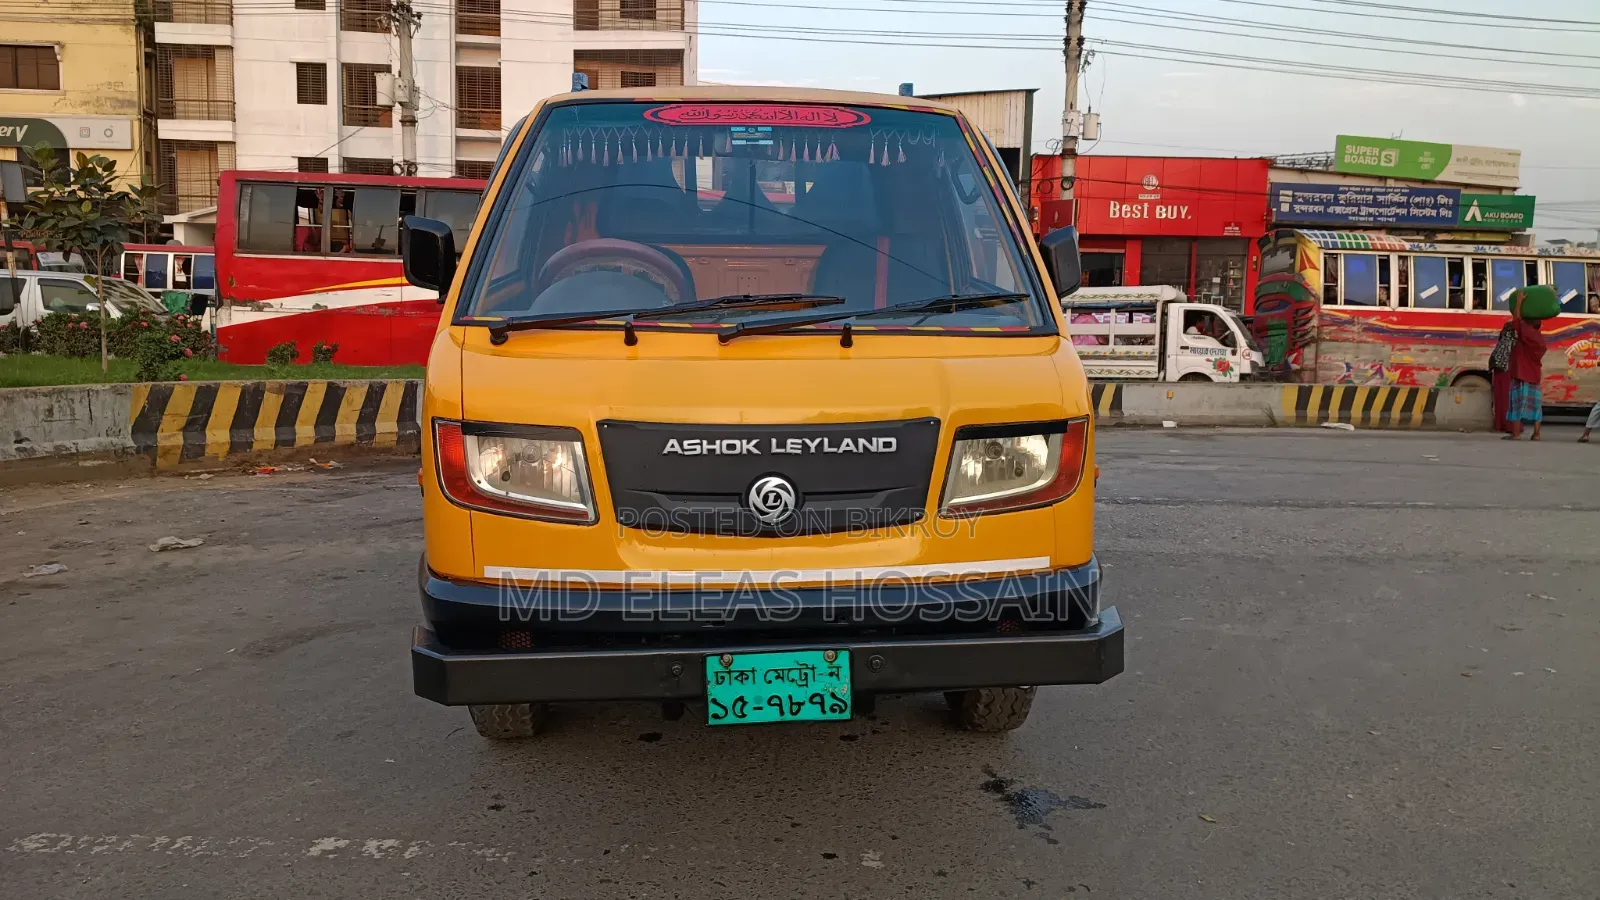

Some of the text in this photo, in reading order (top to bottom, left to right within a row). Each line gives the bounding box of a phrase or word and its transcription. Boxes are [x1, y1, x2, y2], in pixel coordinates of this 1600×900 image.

[1345, 145, 1380, 156] SUPER
[1344, 155, 1378, 165] BOARD
[1109, 200, 1149, 218] Best
[662, 437, 898, 456] ASHOK LEYLAND
[713, 666, 757, 686] ঢাকা
[710, 692, 848, 720] ১৫-৭৮৭৯
